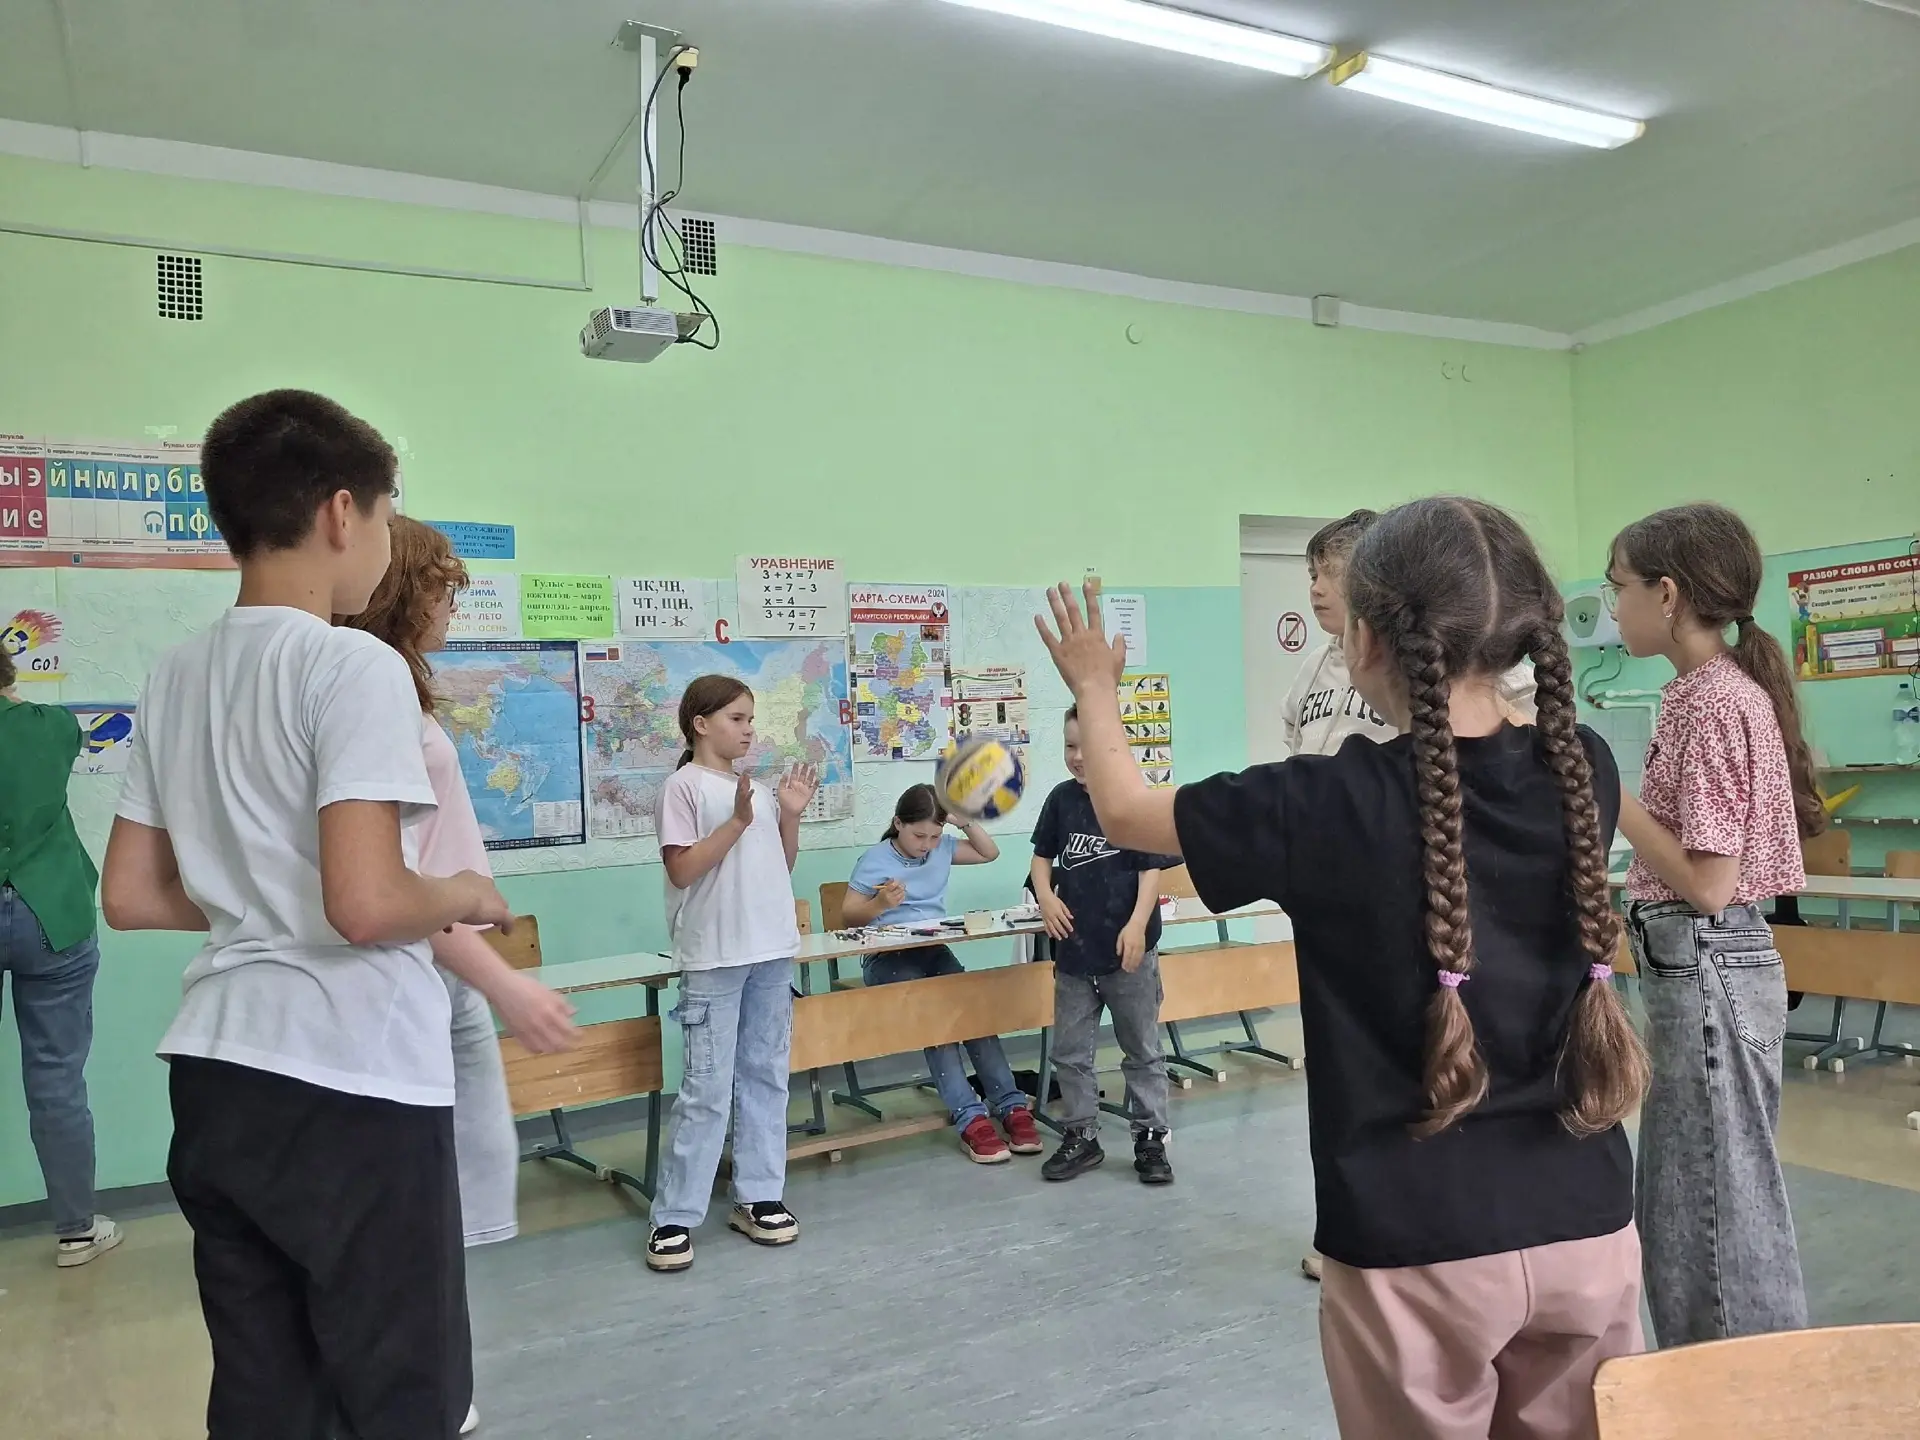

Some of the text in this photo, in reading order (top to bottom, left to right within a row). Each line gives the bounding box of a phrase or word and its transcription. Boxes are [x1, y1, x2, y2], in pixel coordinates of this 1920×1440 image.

[750, 558, 835, 570] УРАВНЕНИЕ
[1802, 557, 1920, 582] РАЗБОР СЛОВА ПО СОСТ
[762, 570, 770, 579] 3
[807, 570, 814, 579] 7
[532, 579, 565, 589] Тулыс
[786, 583, 793, 592] 7
[810, 583, 817, 592] 3
[580, 593, 602, 601] март
[787, 596, 795, 605] 4
[851, 589, 945, 604] КАРТА-СХЕМА 2024
[474, 601, 504, 609] ВЕСНА
[632, 597, 694, 612] ЧТ, ЩН,
[765, 609, 773, 619] 3
[788, 609, 795, 618] 4
[809, 609, 816, 618] 7
[478, 624, 508, 632] ОСЕНЬ
[788, 622, 795, 631] 7
[809, 622, 816, 631] 7
[1067, 833, 1107, 854] NIKE
